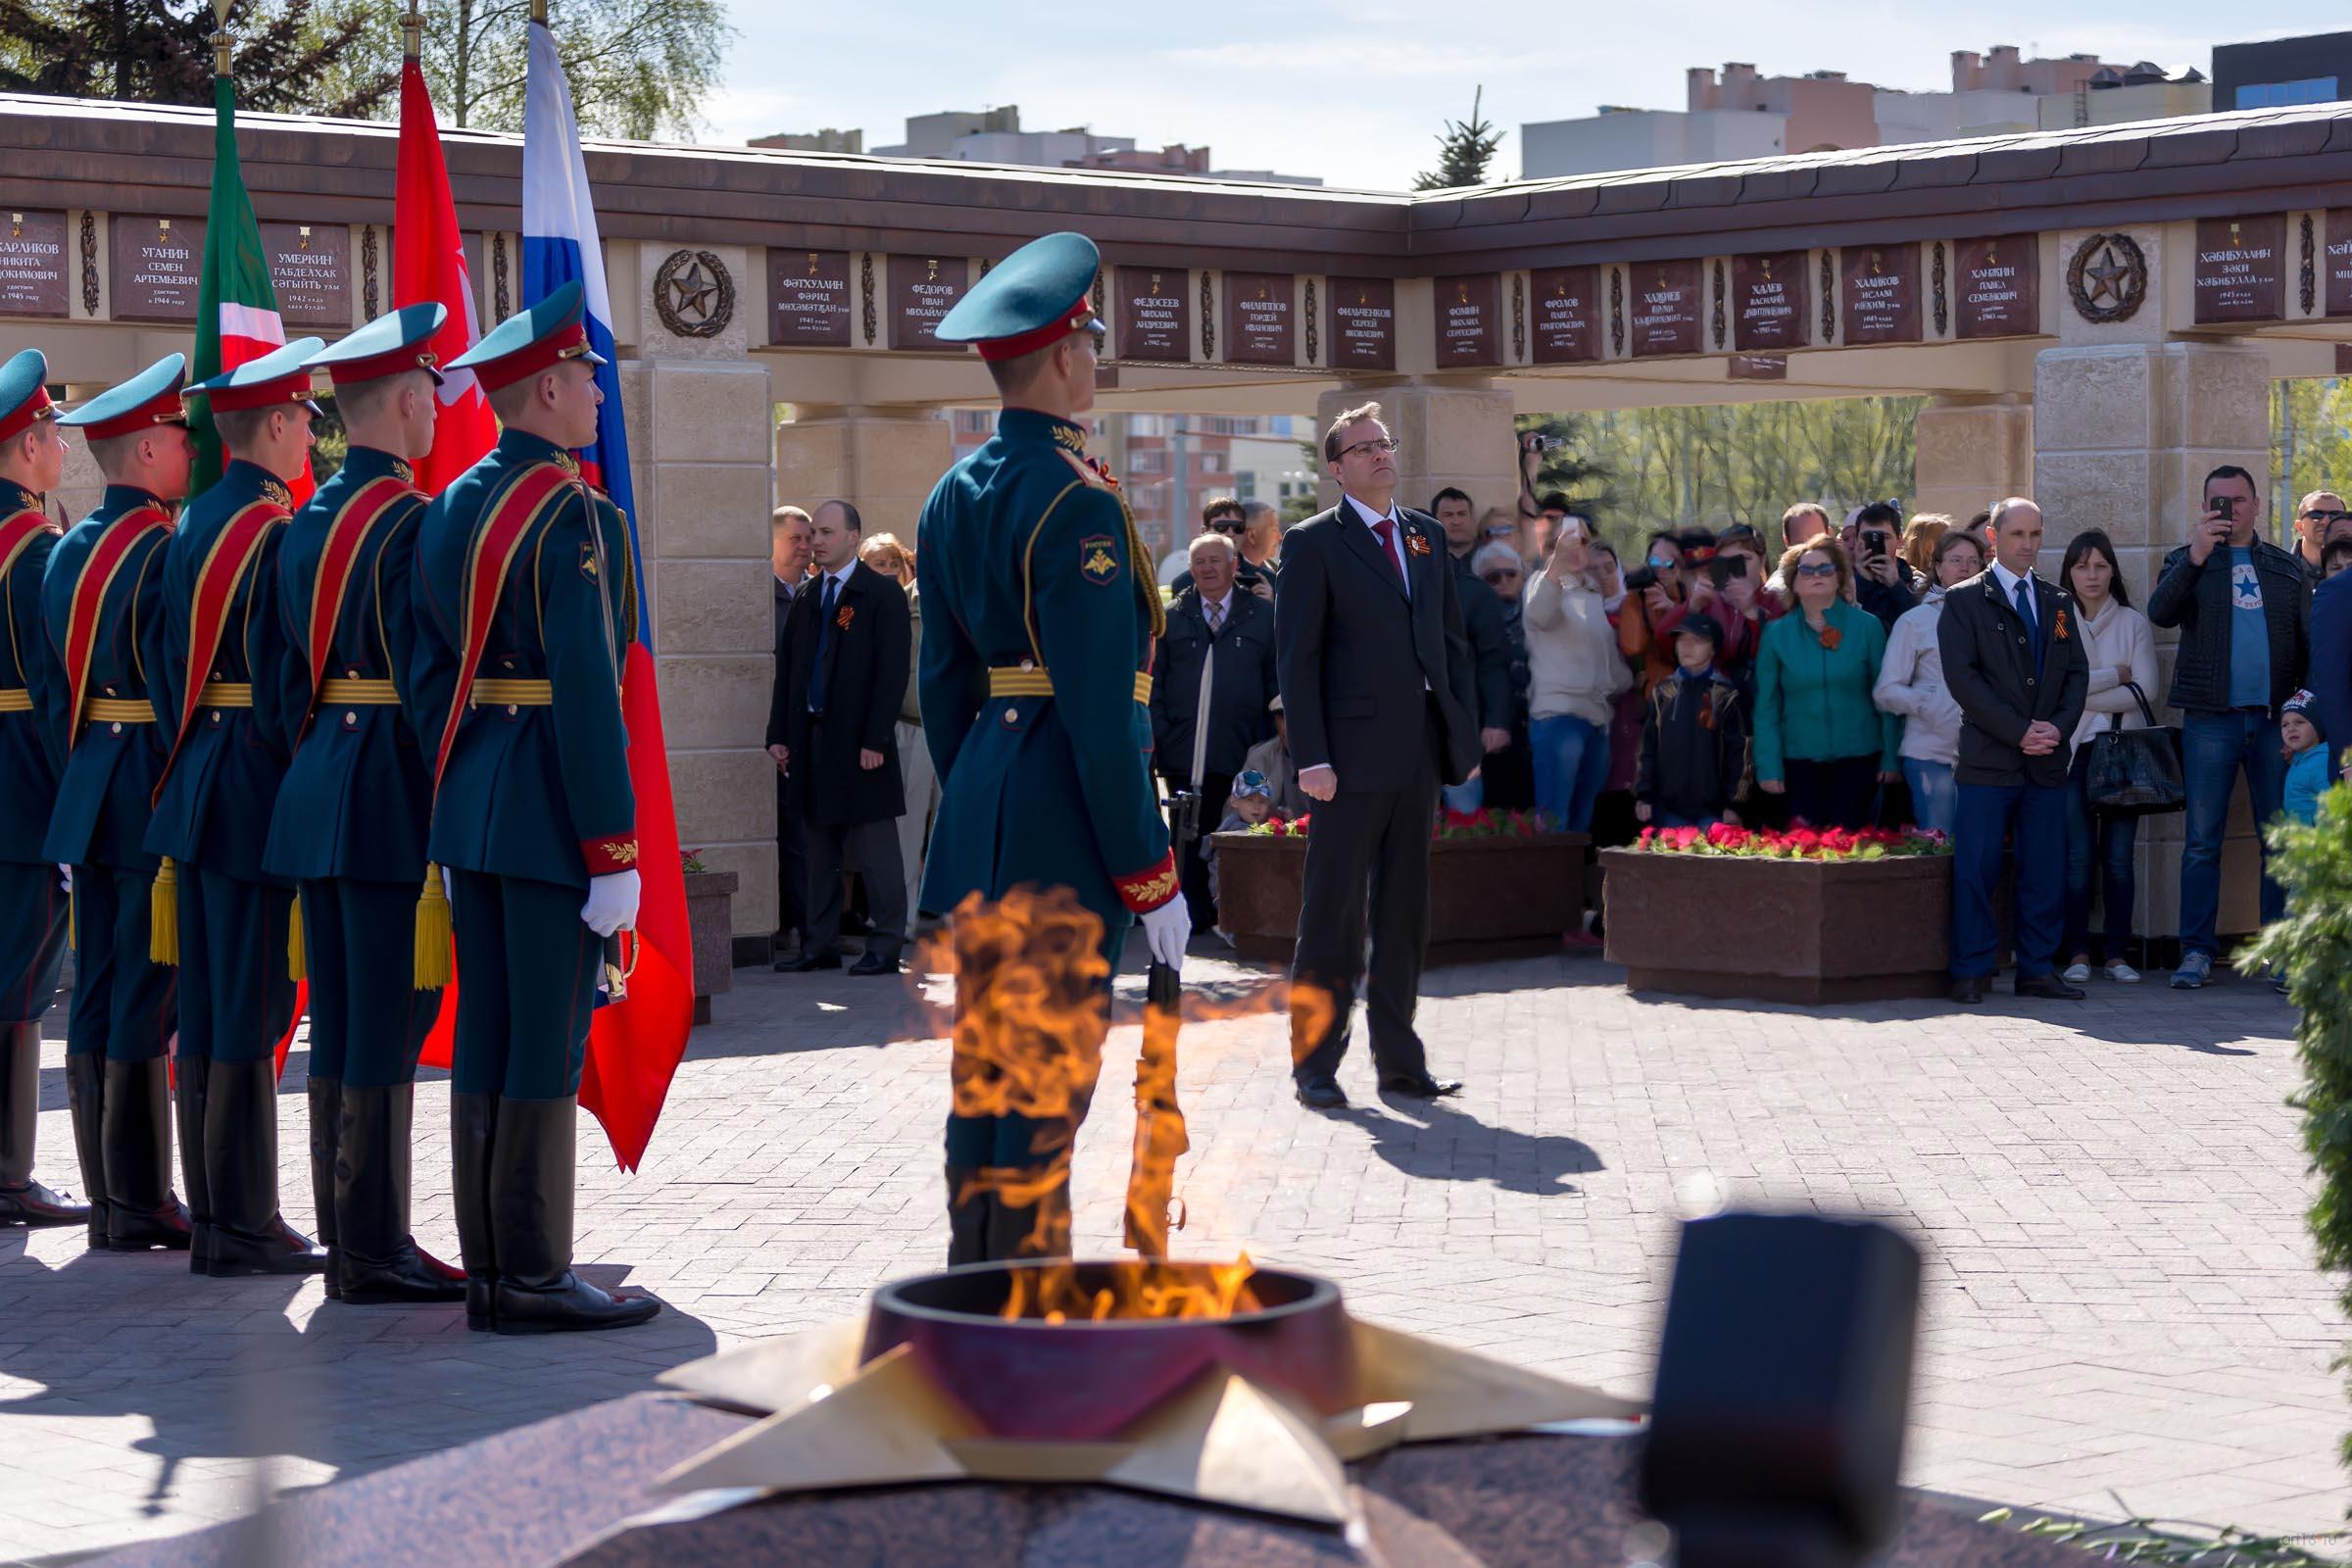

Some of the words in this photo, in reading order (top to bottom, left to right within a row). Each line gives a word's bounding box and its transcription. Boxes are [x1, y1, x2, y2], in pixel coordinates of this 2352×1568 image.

[142, 247, 189, 259] УГАНИН
[277, 253, 332, 266] УМЕРКИН
[148, 262, 183, 272] СЕМЕН
[274, 267, 338, 278] ГАБДЕЛХАК
[133, 274, 199, 285] АРТЕМЬЕВИЧ
[783, 278, 844, 290] ФӘТХУЛЛИН
[912, 284, 954, 295] ФЕДОРОВ
[798, 292, 830, 302] ФӘРИД
[922, 297, 944, 306] ИВАН
[1133, 297, 1180, 308] ФЕДОСЕЕВ
[1240, 301, 1287, 312] ФИЛИППОВ
[1544, 298, 1579, 309] ФРОЛОВ
